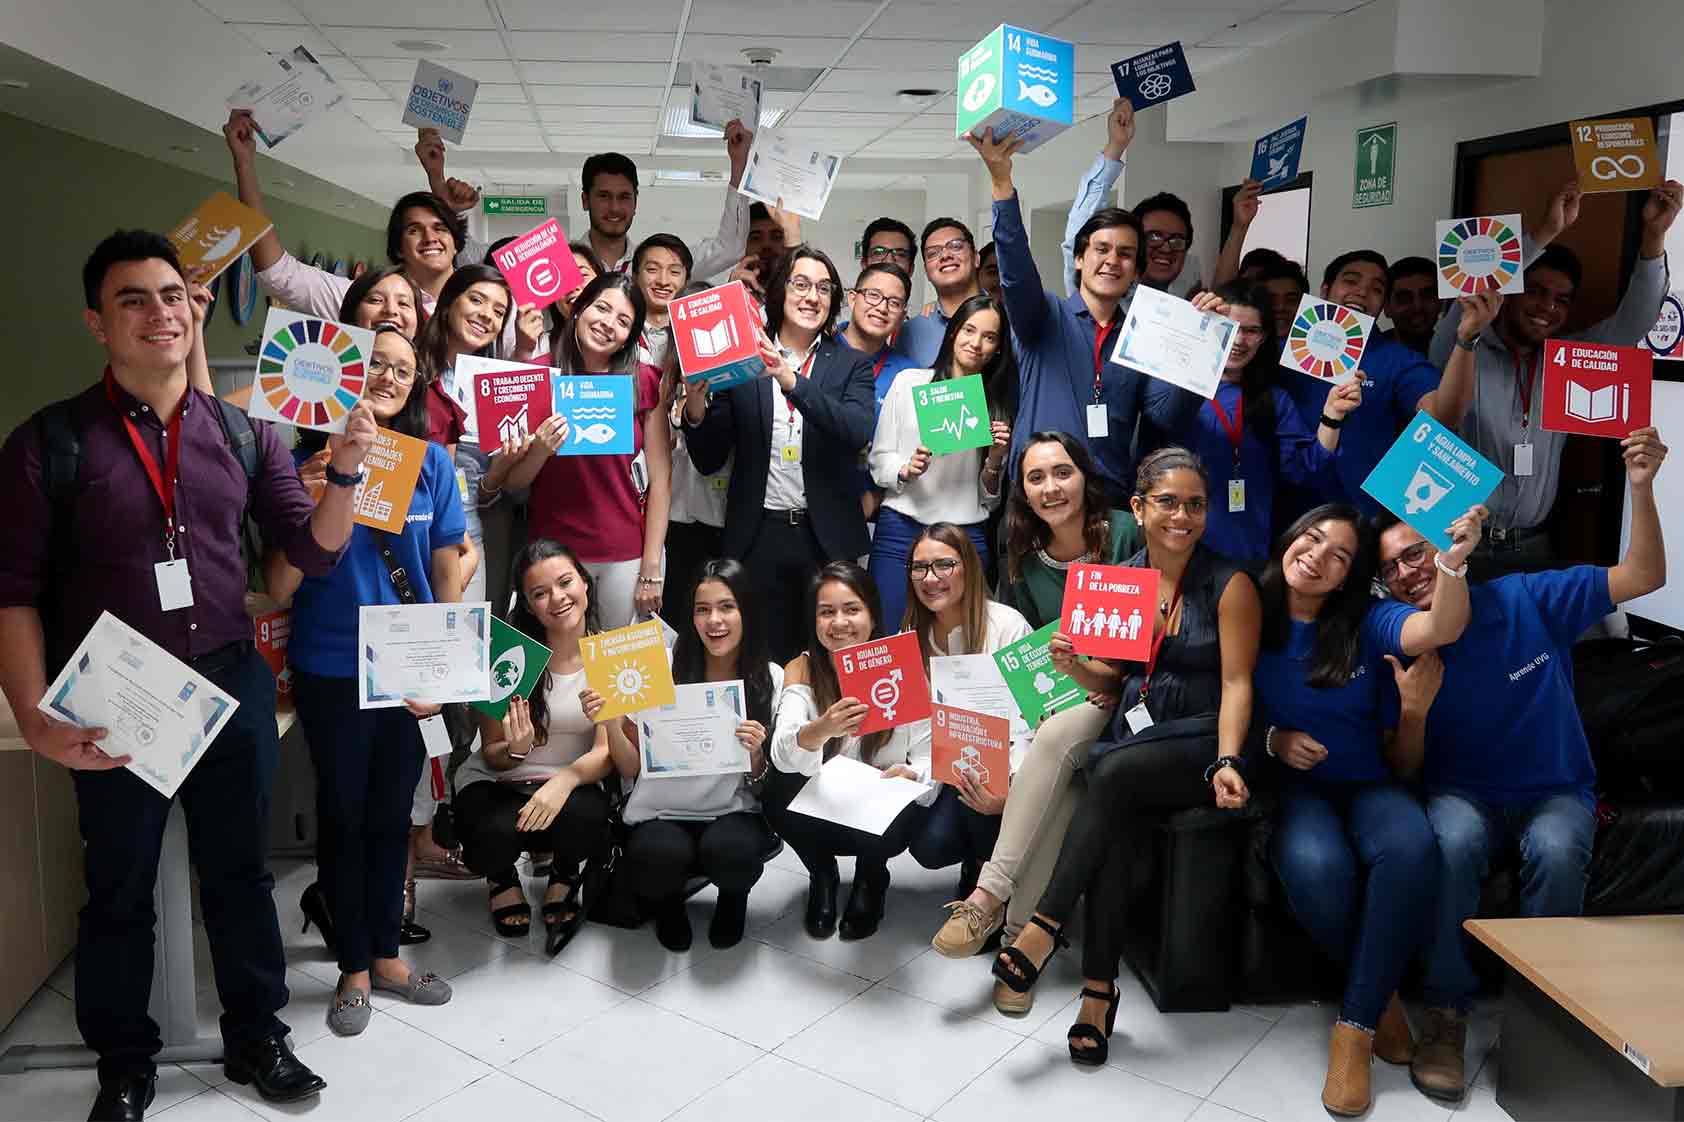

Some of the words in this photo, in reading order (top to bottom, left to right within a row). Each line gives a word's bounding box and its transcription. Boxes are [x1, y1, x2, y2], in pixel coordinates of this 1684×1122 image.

[1008, 33, 1020, 53] 14
[1118, 63, 1129, 77] 17
[412, 84, 472, 113] OBJETIVOS
[1577, 126, 1592, 142] 12
[1360, 178, 1376, 191] ZONA
[1378, 176, 1387, 188] DE
[1354, 190, 1391, 202] SEGURIDAD
[500, 251, 517, 271] 10
[678, 303, 687, 321] 4
[690, 309, 698, 318] DE
[1553, 347, 1566, 367] 4
[1572, 347, 1618, 361] EDUCACIÓN
[1571, 359, 1582, 369] DE
[1583, 360, 1618, 372] CALIDAD
[481, 379, 491, 397] 8
[492, 376, 519, 386] TRABAJO
[520, 373, 544, 383] DECENTE
[494, 387, 498, 395] Y
[498, 384, 536, 395] CRECIMIENTO
[494, 393, 528, 404] ECONÓMICO
[560, 381, 575, 400] 14
[919, 390, 929, 406] 3
[1413, 423, 1431, 442] 6
[1434, 432, 1454, 450] AGUA
[1452, 446, 1476, 468] LIMPIA
[1432, 446, 1480, 485] SANEAMIENTO
[1077, 570, 1084, 590] 1
[1090, 571, 1102, 580] FIN
[1089, 581, 1098, 590] DE
[1099, 582, 1107, 592] LA
[1108, 583, 1139, 594] POBREZA
[261, 622, 269, 641] 9
[584, 642, 596, 661] 7
[857, 645, 888, 660] IGUALDAD
[842, 654, 854, 674] 5
[858, 661, 868, 670] DE
[868, 655, 892, 668] GÉNERO
[1001, 651, 1019, 672] 15
[1509, 661, 1535, 681] Aprende
[1535, 652, 1550, 665] UVG
[937, 710, 945, 728] 9
